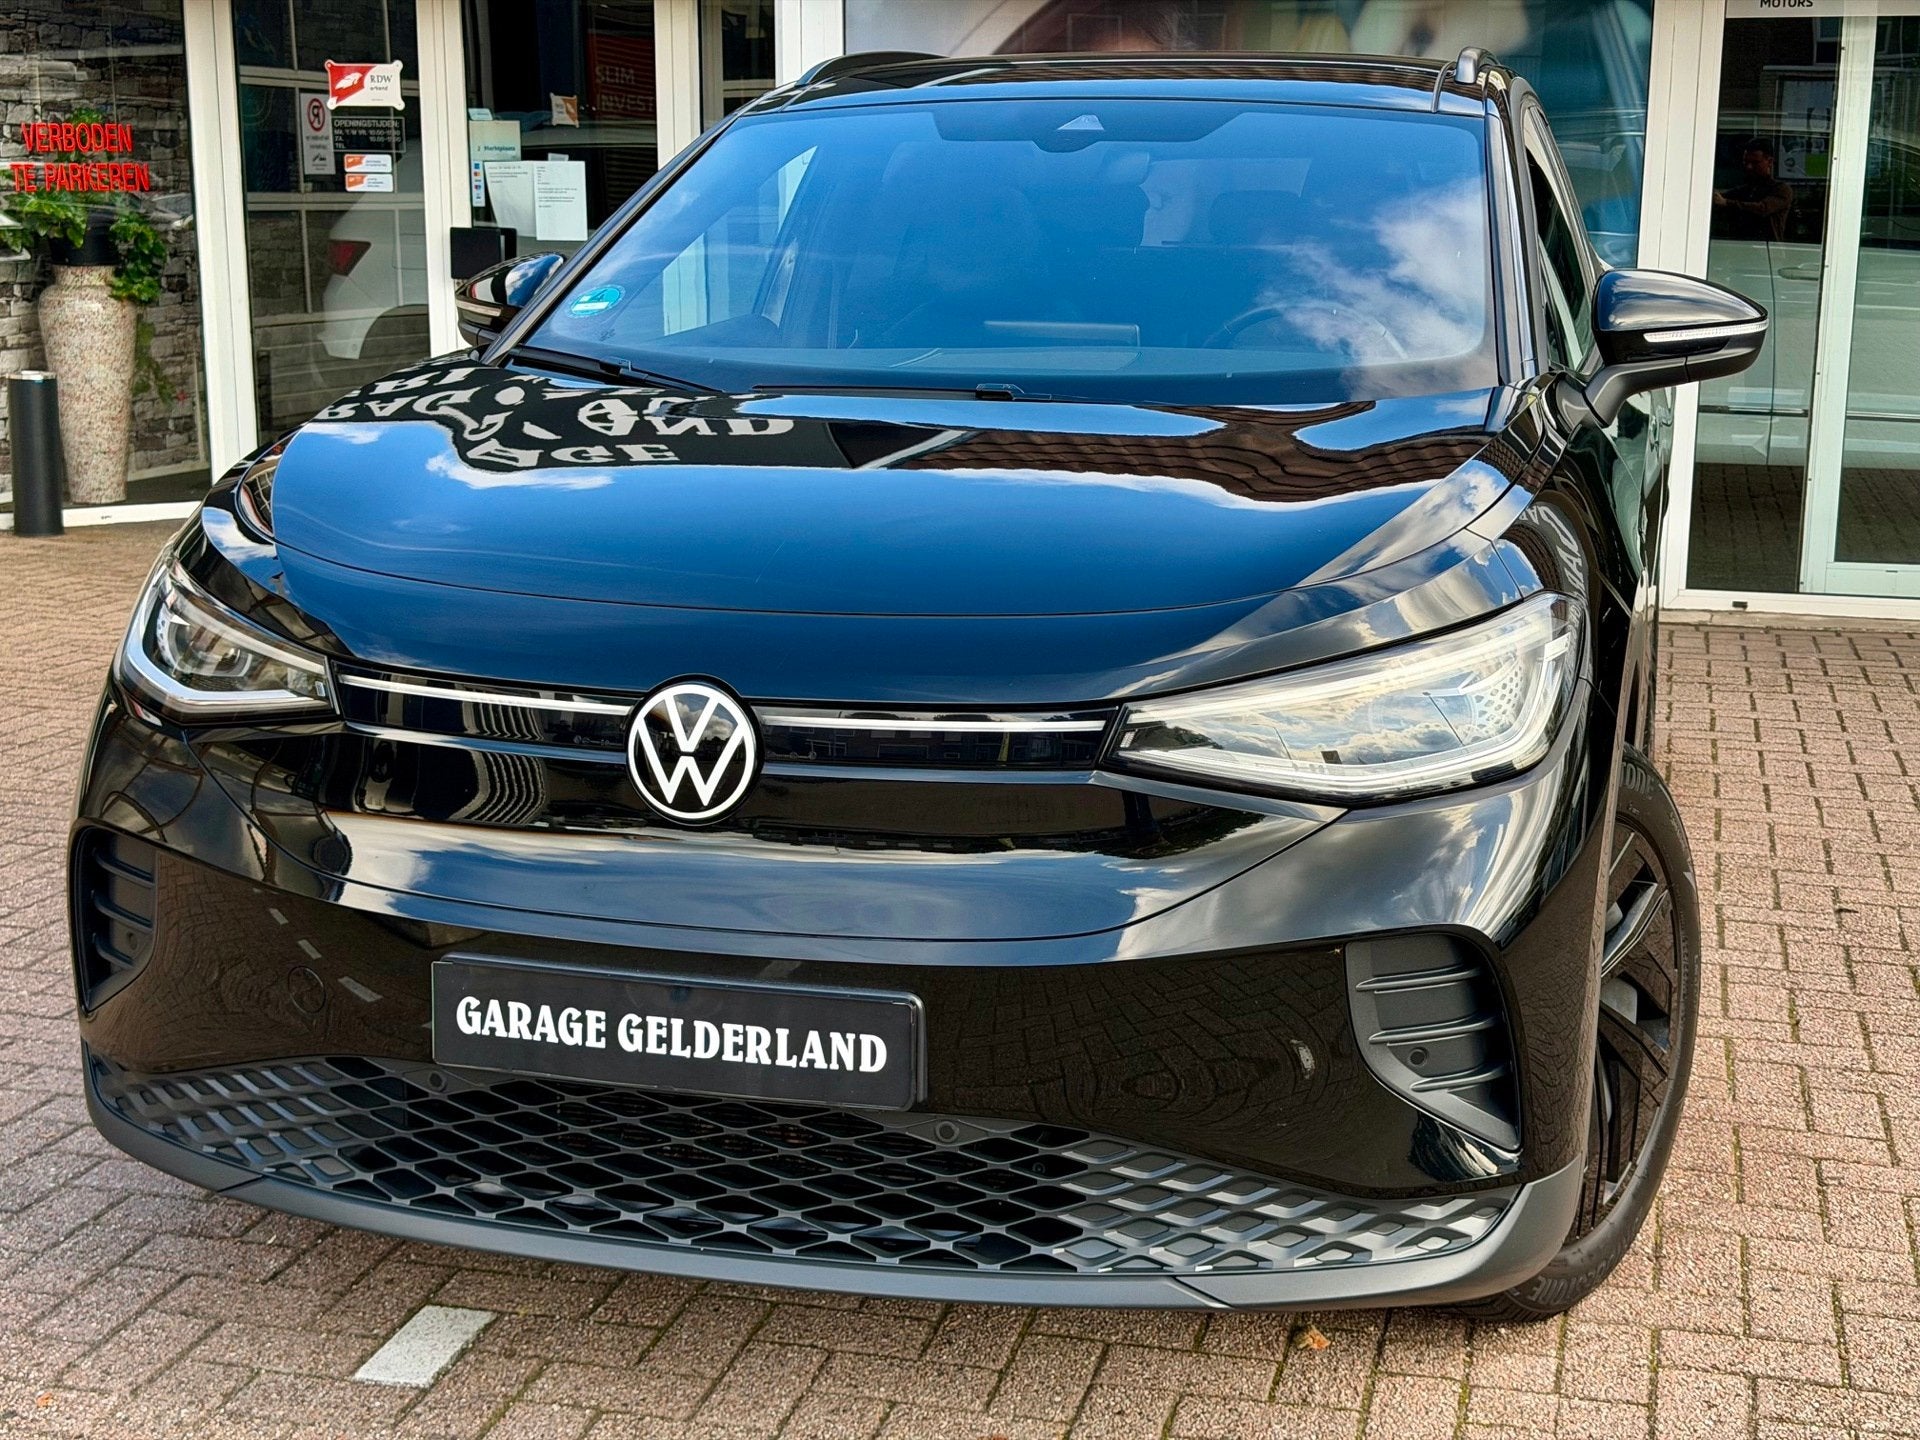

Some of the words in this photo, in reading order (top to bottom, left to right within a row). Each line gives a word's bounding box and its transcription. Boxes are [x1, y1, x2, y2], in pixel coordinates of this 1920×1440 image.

[1760, 0, 1813, 8] MOTORS
[370, 75, 392, 83] RDW
[21, 122, 133, 153] VERBODEN
[10, 163, 37, 192] TE
[44, 162, 149, 192] PARKEREN
[456, 995, 606, 1048] GARAGE
[617, 1013, 888, 1073] GELDERLAND
